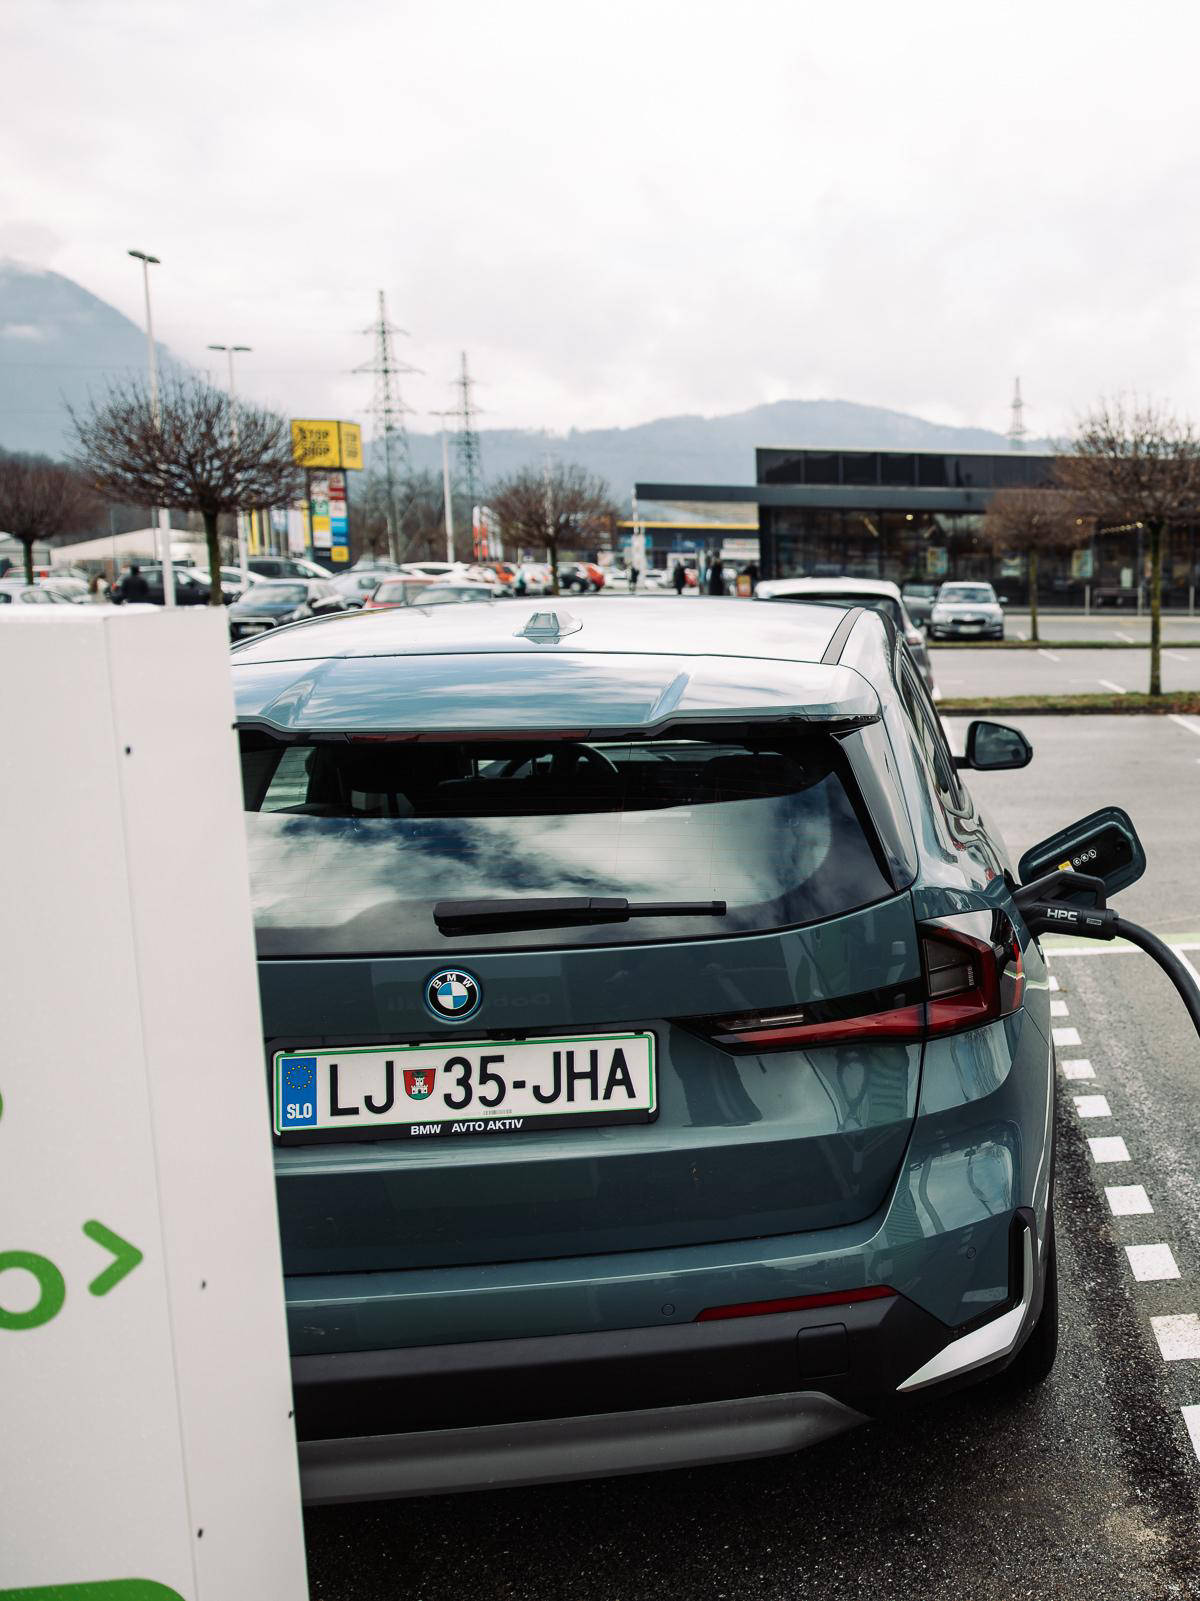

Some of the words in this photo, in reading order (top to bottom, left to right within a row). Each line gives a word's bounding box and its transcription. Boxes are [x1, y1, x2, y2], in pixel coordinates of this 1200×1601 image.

[1047, 908, 1078, 921] HPC
[432, 973, 473, 989] BMW
[329, 1060, 395, 1117] LJ
[443, 1047, 637, 1109] 35-JHA
[286, 1102, 313, 1120] SLO
[410, 1124, 442, 1136] BMW
[451, 1121, 485, 1133] AVTO
[487, 1118, 524, 1131] AKTIV
